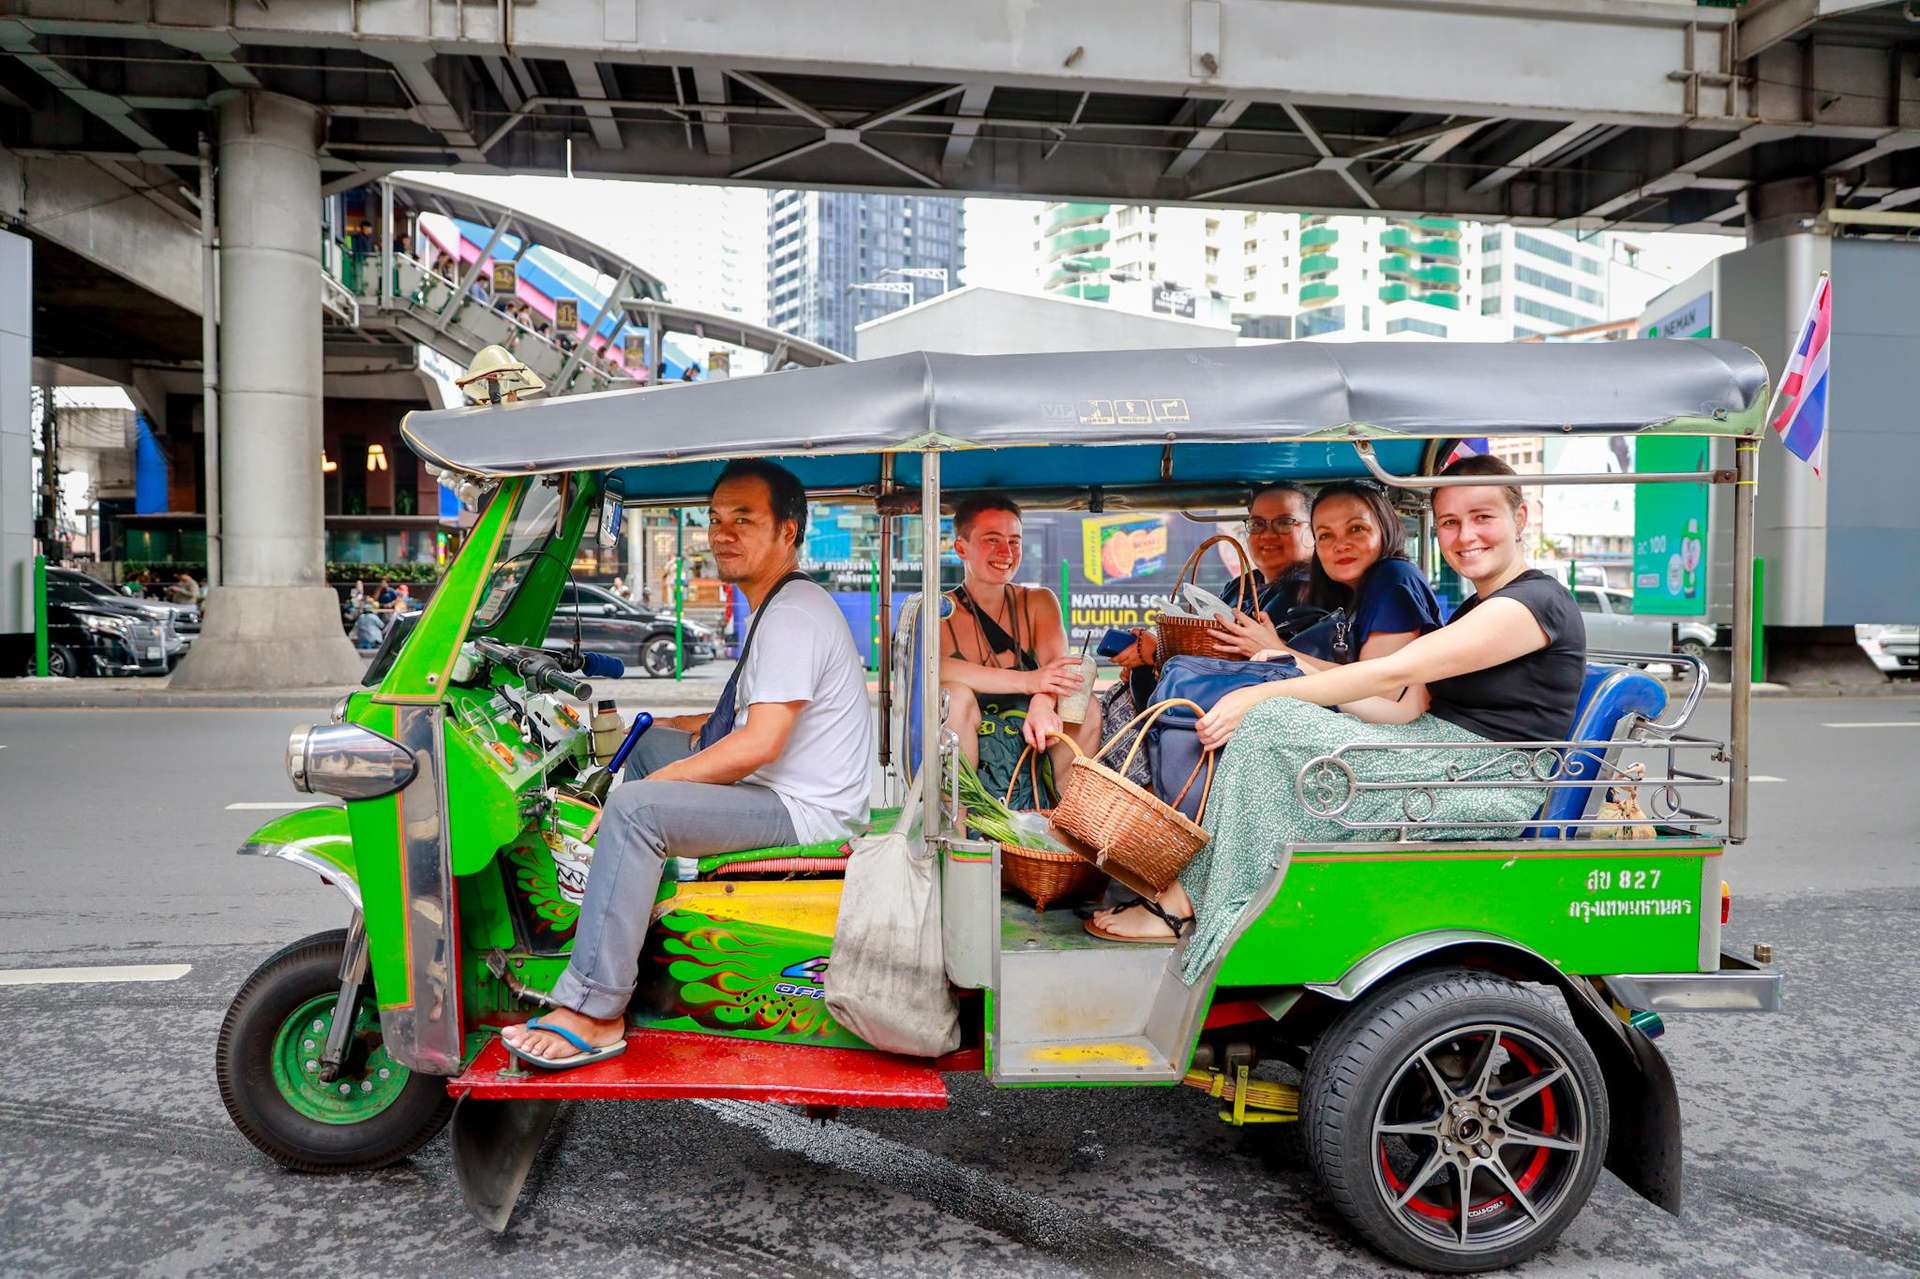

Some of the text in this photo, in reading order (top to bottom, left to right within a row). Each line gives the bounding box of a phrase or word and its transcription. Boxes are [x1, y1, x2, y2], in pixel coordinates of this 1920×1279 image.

[1071, 594, 1138, 608] NATURAL
[1619, 869, 1661, 889] 827
[1569, 899, 1692, 924] กรุงเทพมหานคร
